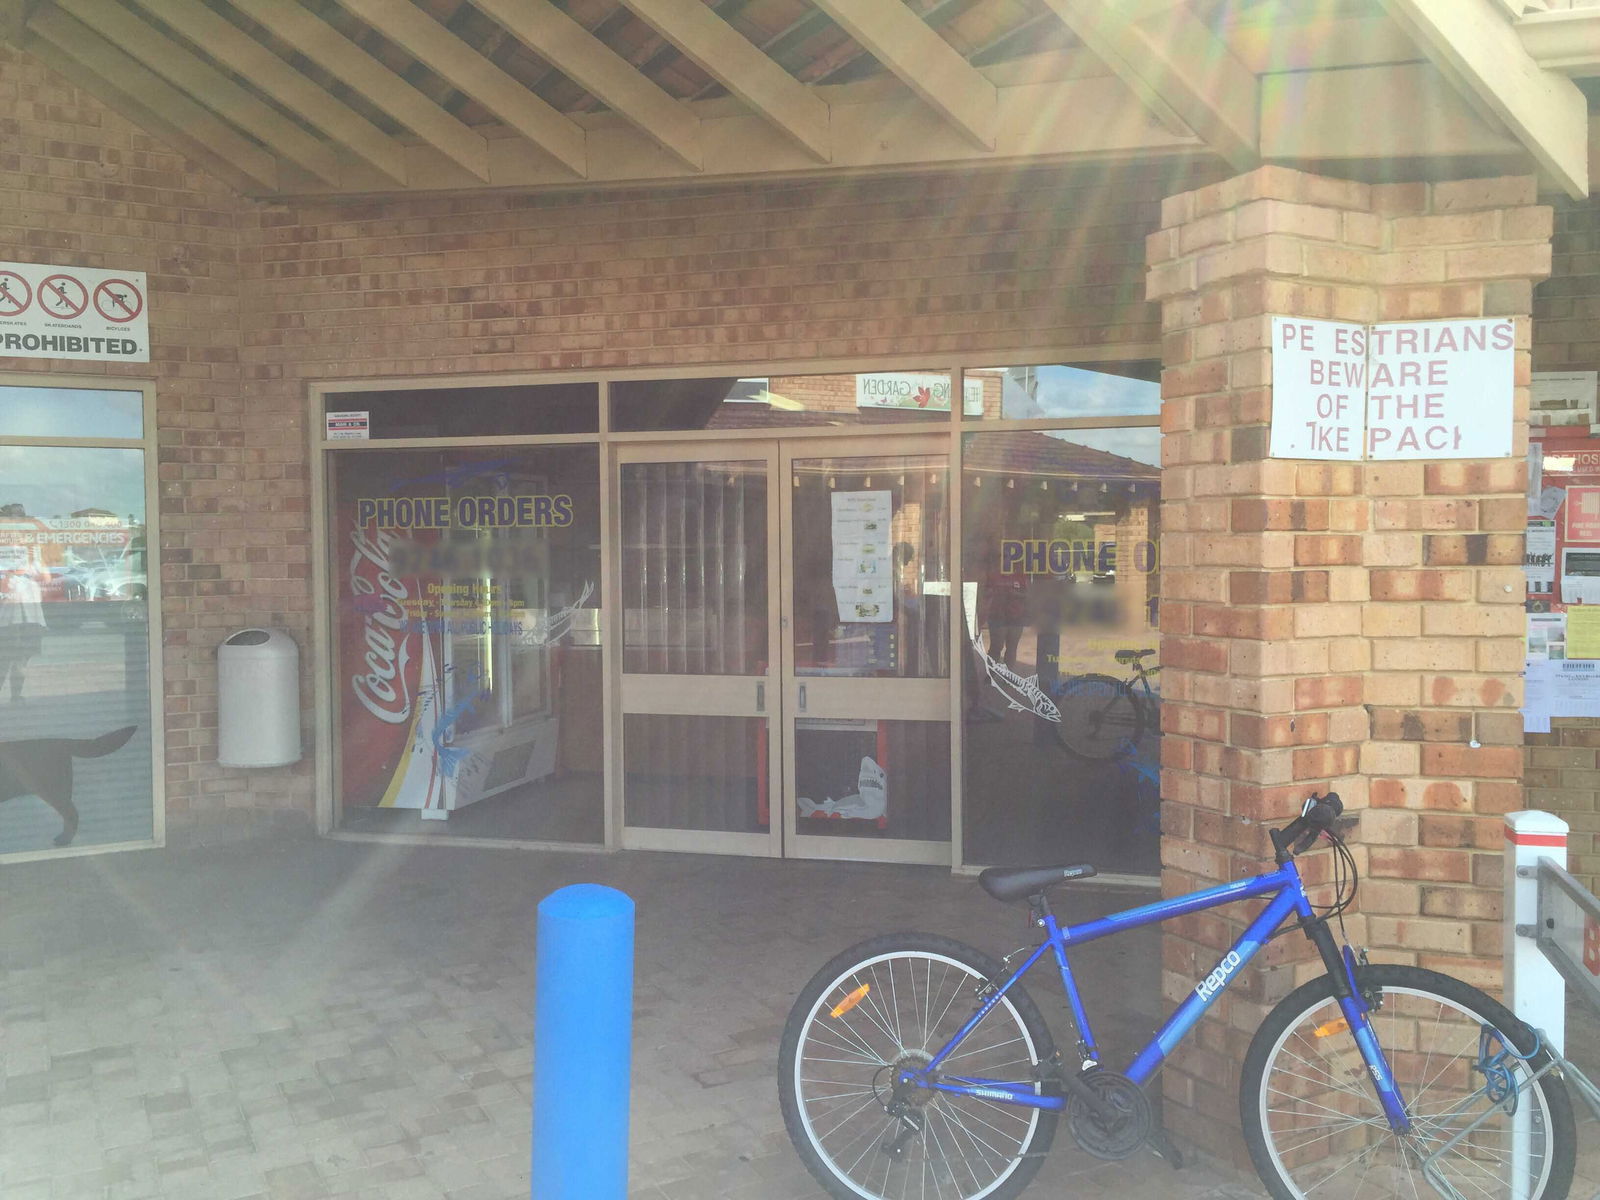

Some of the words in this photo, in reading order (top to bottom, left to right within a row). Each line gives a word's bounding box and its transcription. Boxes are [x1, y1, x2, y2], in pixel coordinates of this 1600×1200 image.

[0, 333, 138, 355] ROHIBITED
[1310, 359, 1449, 388] BEWARE
[1316, 393, 1349, 419] OF
[1370, 393, 1445, 420] THE
[1573, 454, 1600, 465] HOS
[358, 497, 451, 529] PHONE
[456, 494, 574, 528] ORDERS
[1001, 539, 1118, 575] PHONE
[1132, 540, 1160, 575] O
[1194, 950, 1242, 1002] Repco
